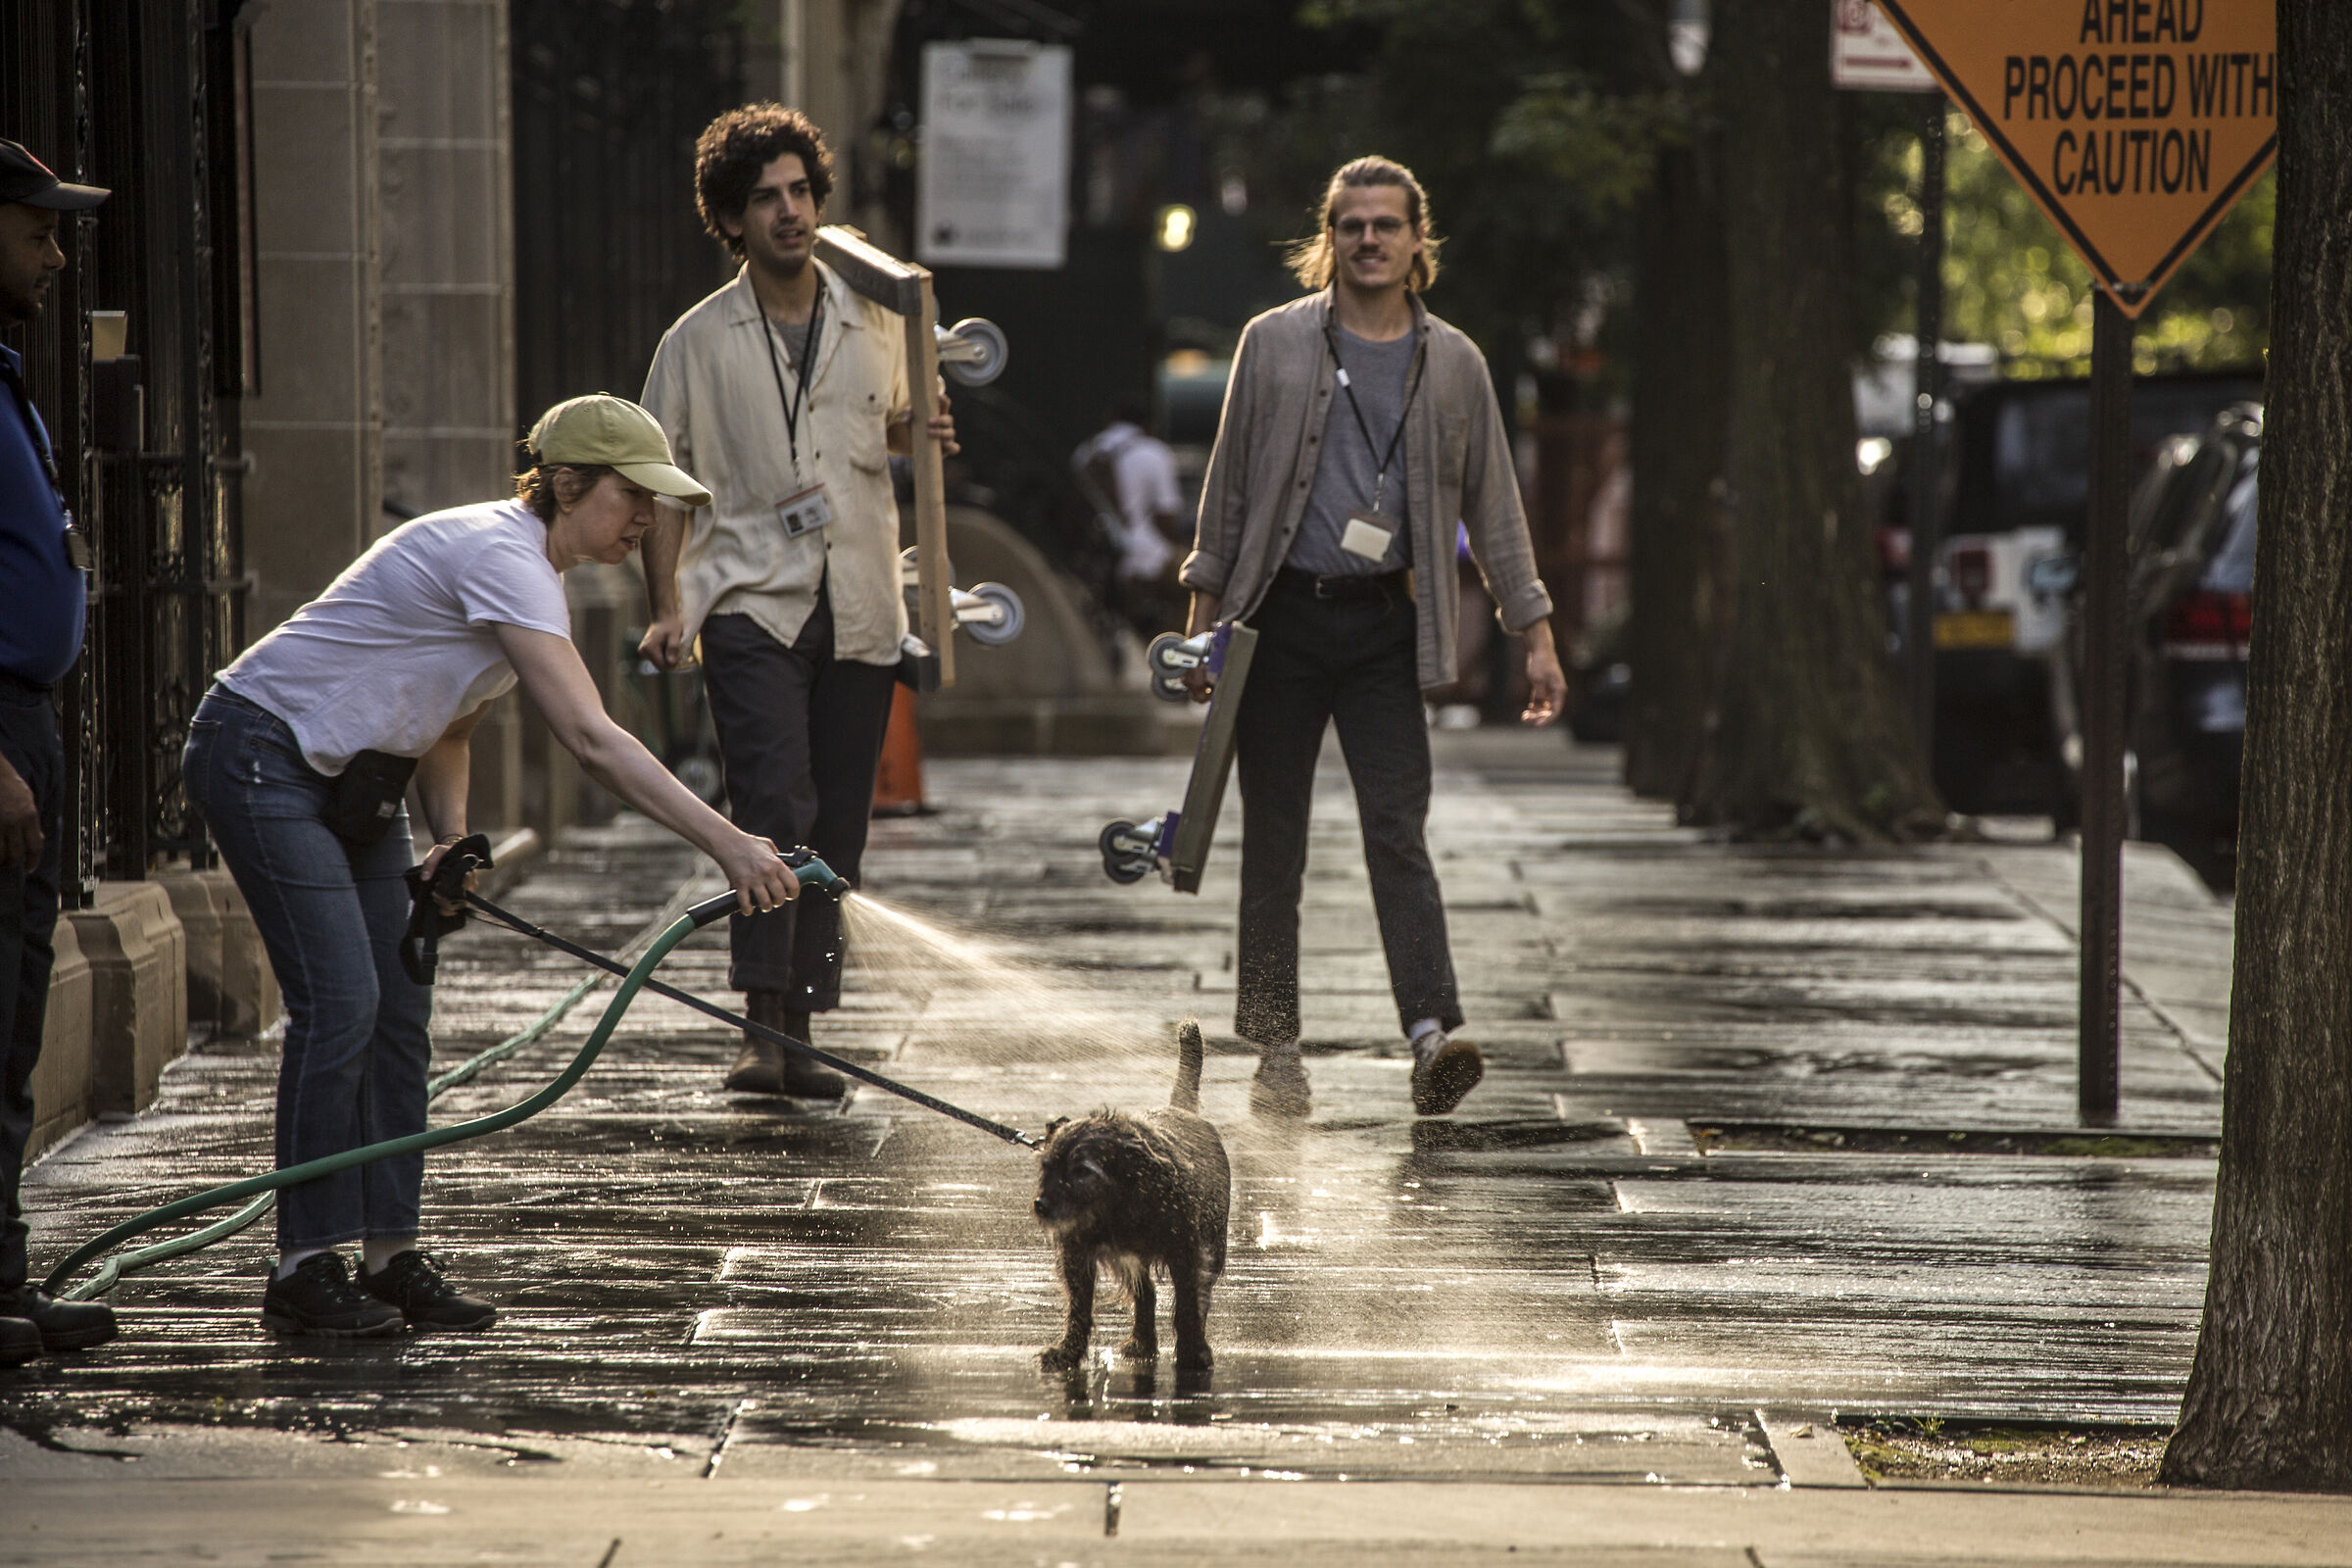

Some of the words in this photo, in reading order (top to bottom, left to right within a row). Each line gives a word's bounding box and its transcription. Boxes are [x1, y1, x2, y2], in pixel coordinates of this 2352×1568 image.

[2080, 0, 2203, 44] AHEAD
[2004, 54, 2176, 121] PROCEED
[2187, 53, 2275, 118] WITH
[2053, 127, 2211, 196] CAUTION
